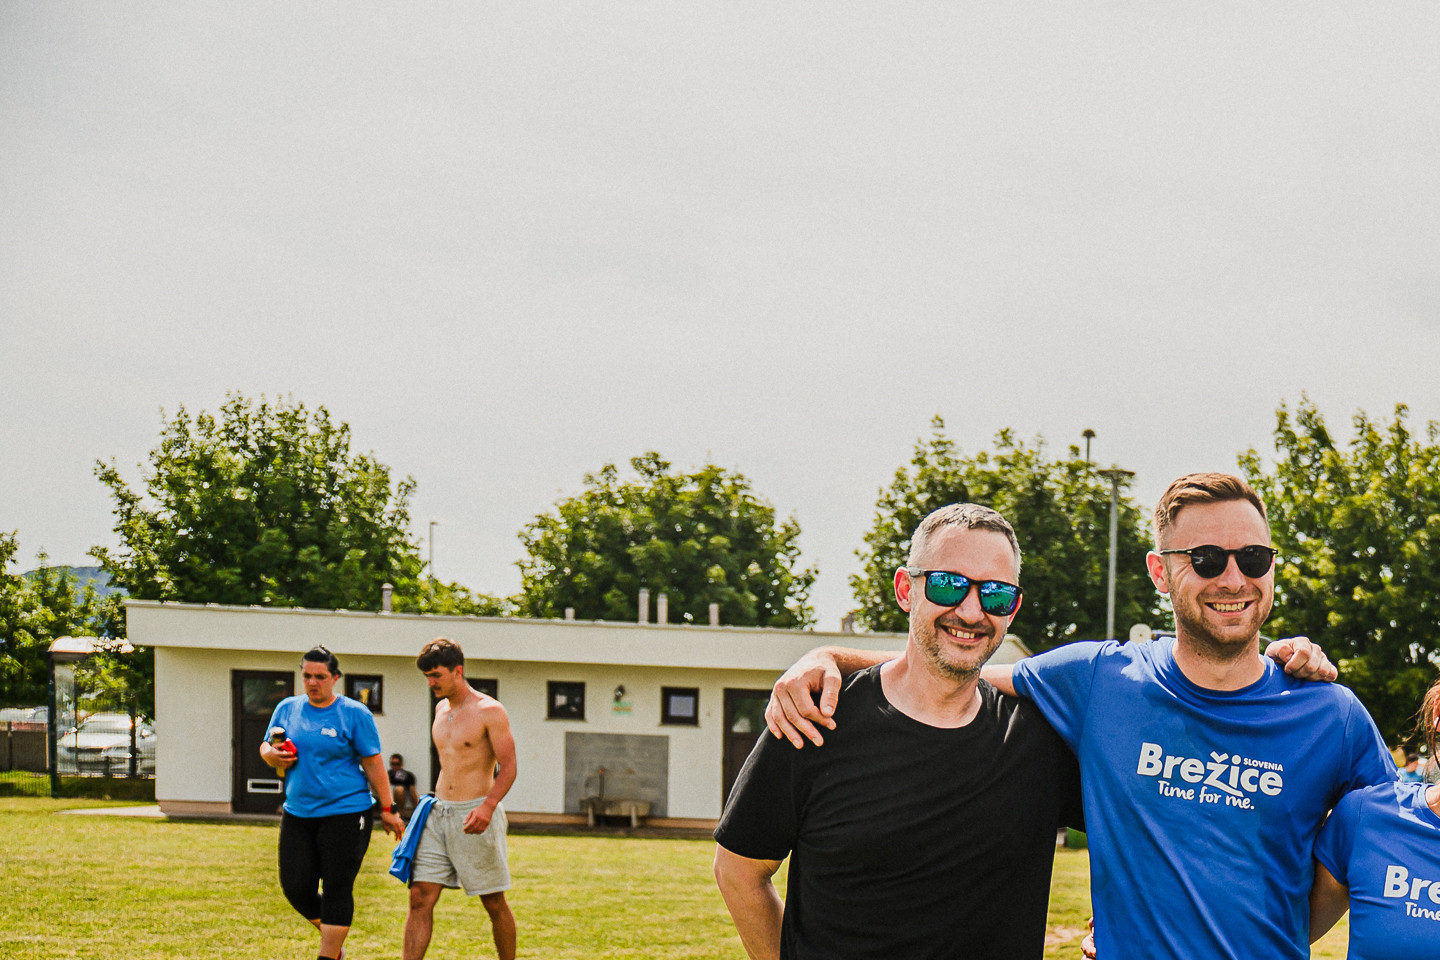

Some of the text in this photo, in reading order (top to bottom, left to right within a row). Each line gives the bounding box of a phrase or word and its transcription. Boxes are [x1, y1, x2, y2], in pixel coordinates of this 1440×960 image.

[1136, 742, 1284, 798] Brežice SLOVENIA
[1157, 779, 1255, 810] Time for me.
